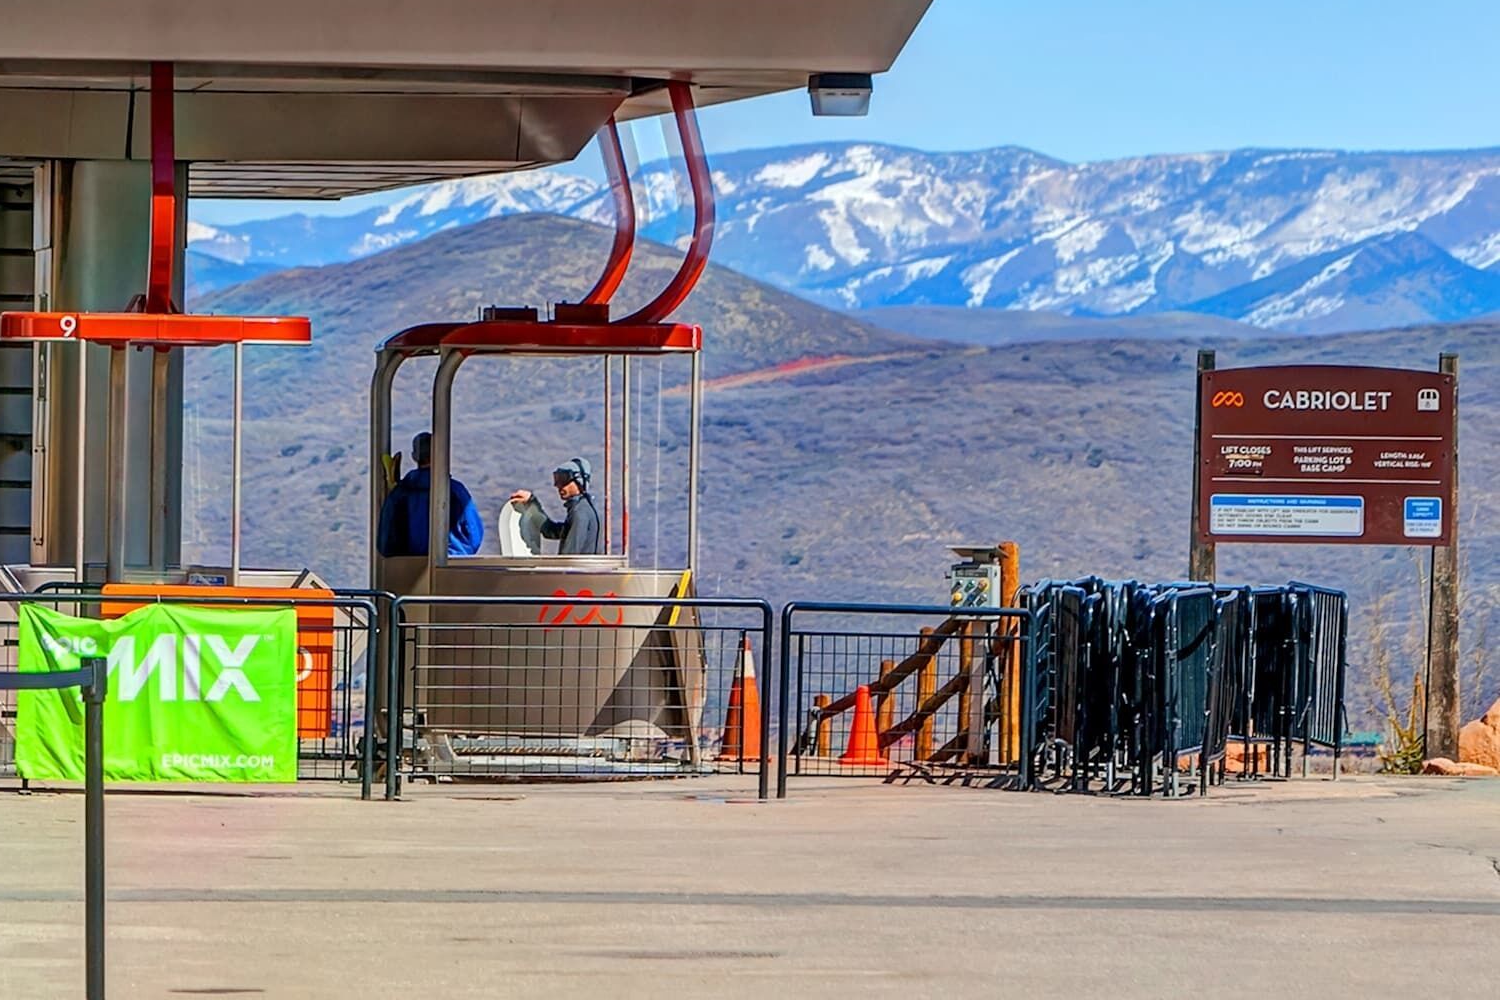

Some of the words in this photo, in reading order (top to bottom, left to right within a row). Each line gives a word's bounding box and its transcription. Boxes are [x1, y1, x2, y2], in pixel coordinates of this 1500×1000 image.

[59, 315, 77, 337] 9
[1263, 390, 1392, 411] CABRIOLET
[1221, 446, 1239, 454] LIFT
[1240, 446, 1271, 454] CLOSES
[1228, 459, 1252, 468] 7:00
[1293, 456, 1328, 464] PARKING
[1329, 456, 1344, 464] LOT
[1301, 464, 1321, 472] BASE
[77, 634, 262, 701] MIX
[161, 754, 275, 769] EPICMIX.COM
